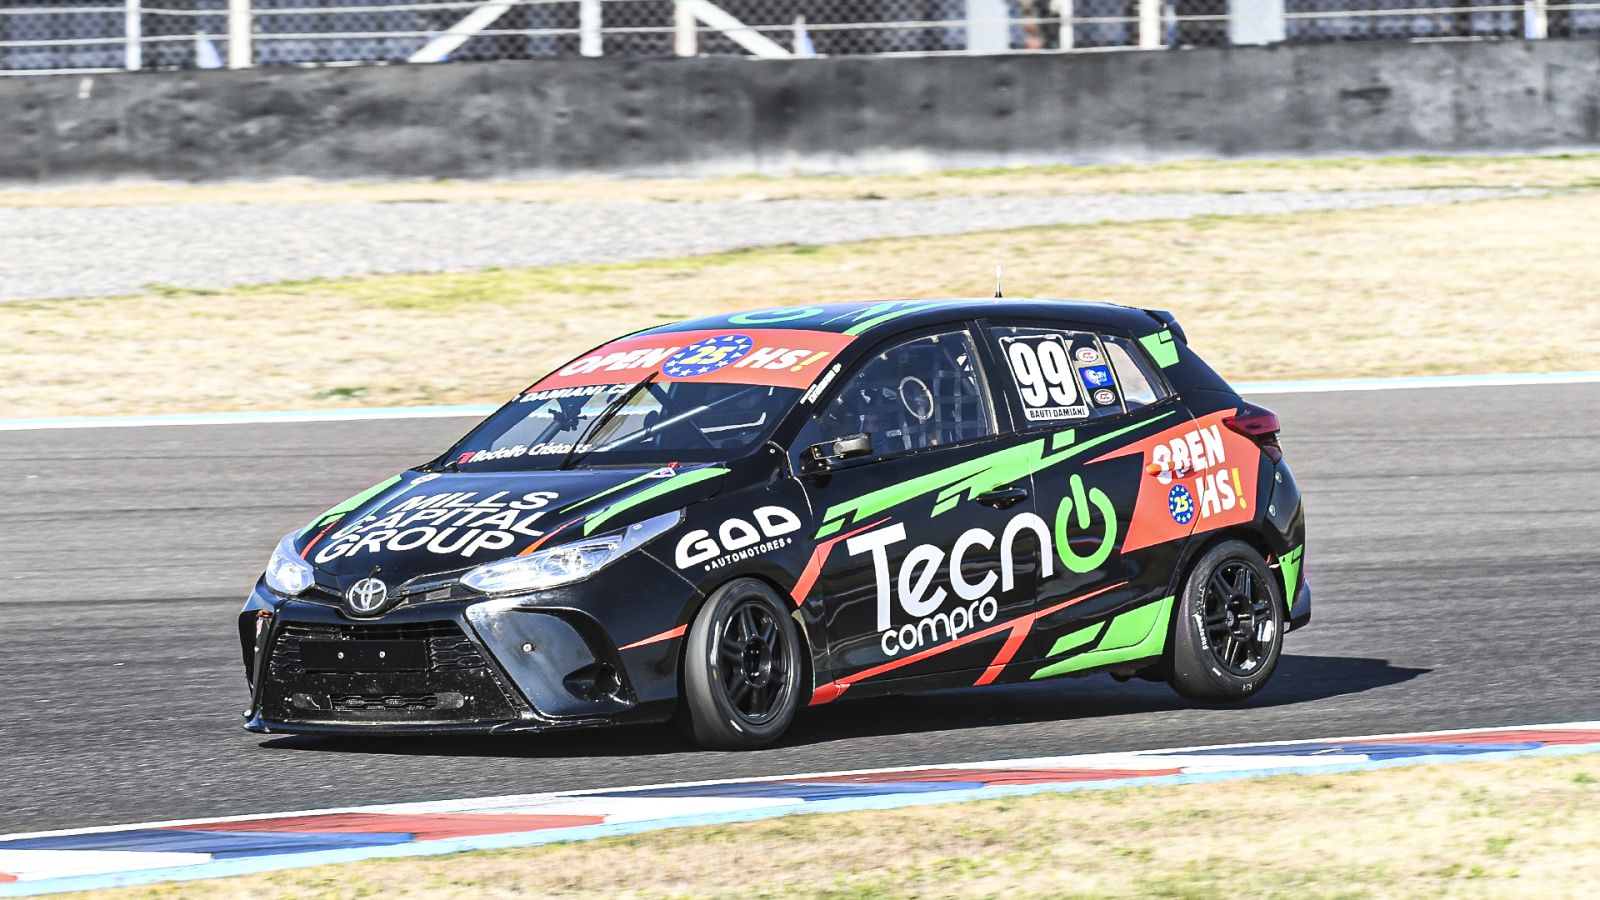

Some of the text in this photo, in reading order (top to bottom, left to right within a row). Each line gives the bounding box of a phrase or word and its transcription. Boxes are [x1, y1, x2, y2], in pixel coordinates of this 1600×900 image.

[558, 345, 829, 377] OPEN 25 HS!
[1009, 340, 1078, 408] 99
[519, 384, 604, 403] DAMIANI
[1030, 407, 1086, 419] BAUTI DAMIANI
[468, 444, 528, 463] Rodolfo
[1152, 424, 1226, 485] OPEN
[389, 491, 559, 513] MILLS
[1174, 495, 1189, 514] 25
[1195, 467, 1247, 519] HS!
[331, 507, 545, 541] CAPITAL
[314, 527, 515, 564] GROUP
[711, 537, 787, 570] AUTOMOTORES
[881, 596, 998, 656] compro
